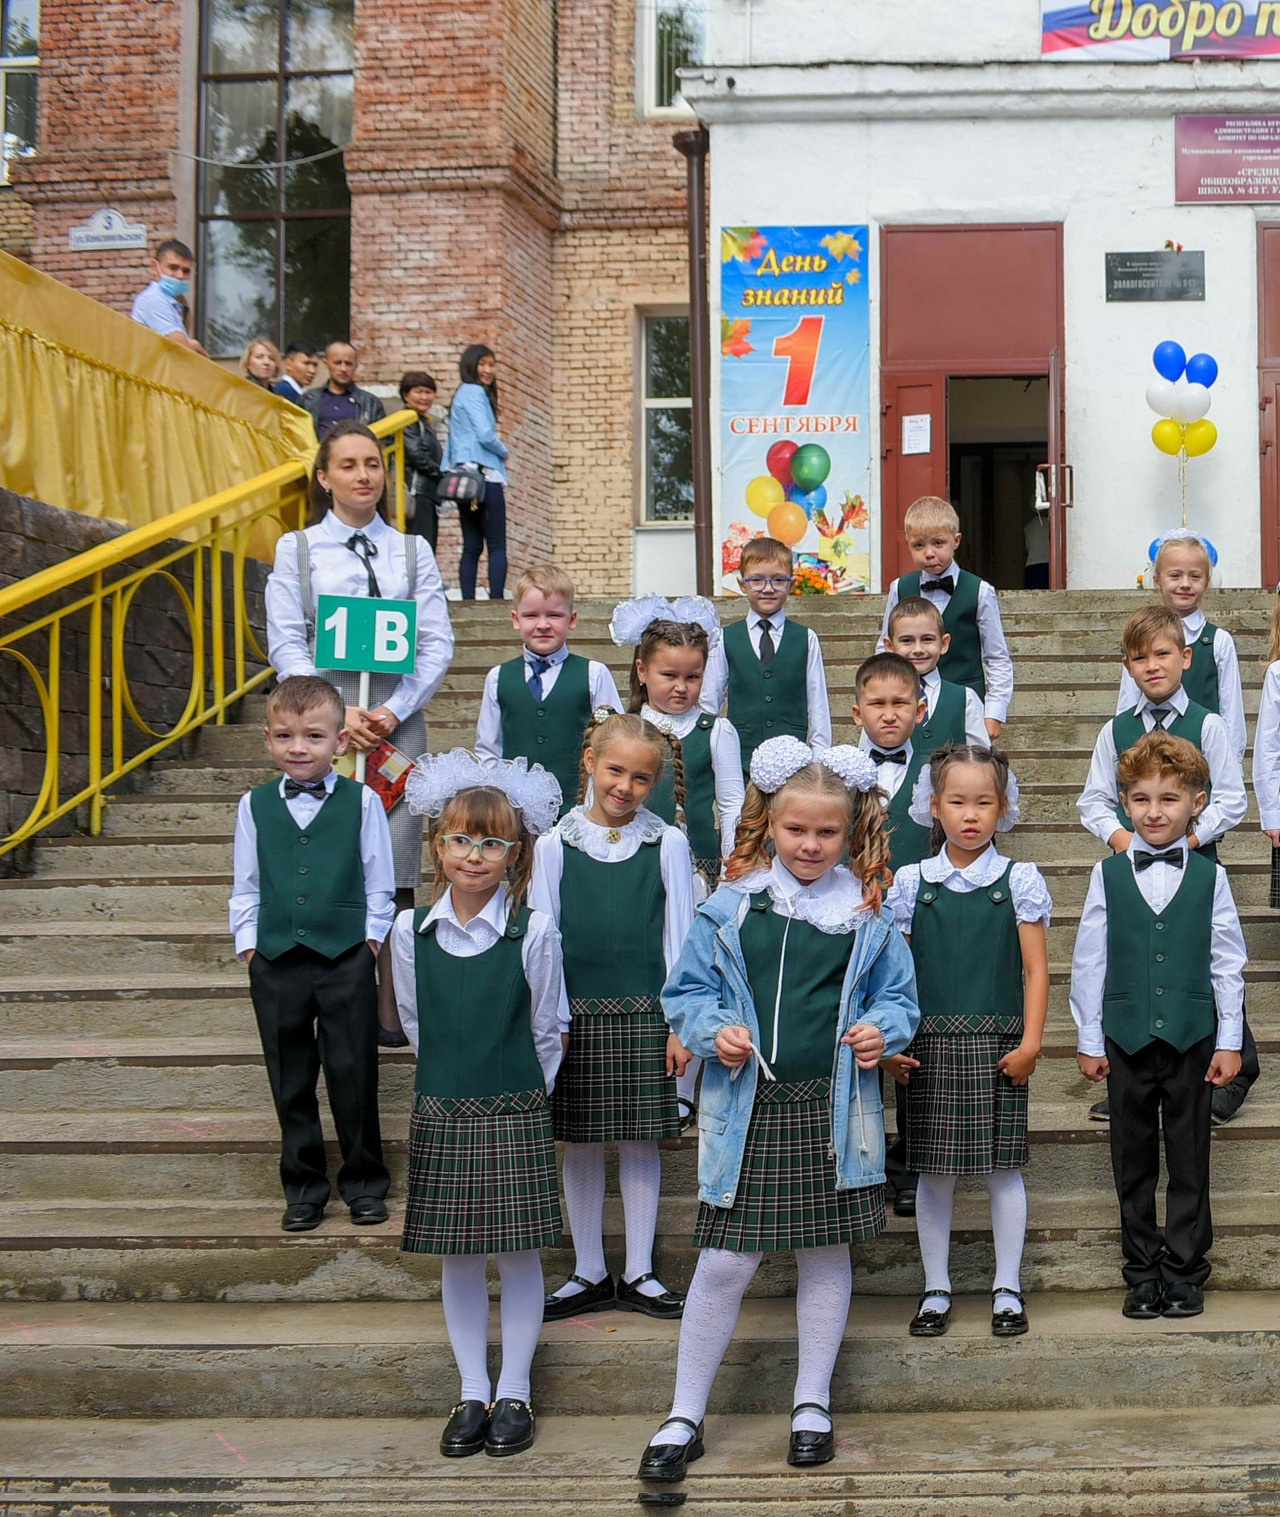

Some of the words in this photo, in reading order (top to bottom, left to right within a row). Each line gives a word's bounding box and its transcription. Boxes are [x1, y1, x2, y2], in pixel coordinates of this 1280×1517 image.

[1088, 0, 1244, 51] Добро
[1198, 186, 1234, 195] ШКОЛА
[1248, 186, 1259, 195] 42
[104, 216, 113, 231] 3
[756, 248, 829, 278] День
[741, 282, 845, 307] знаний
[772, 315, 825, 407] 1
[730, 414, 859, 436] СЕНТЯБРЯ
[324, 606, 349, 660] 1
[374, 610, 410, 662] В
